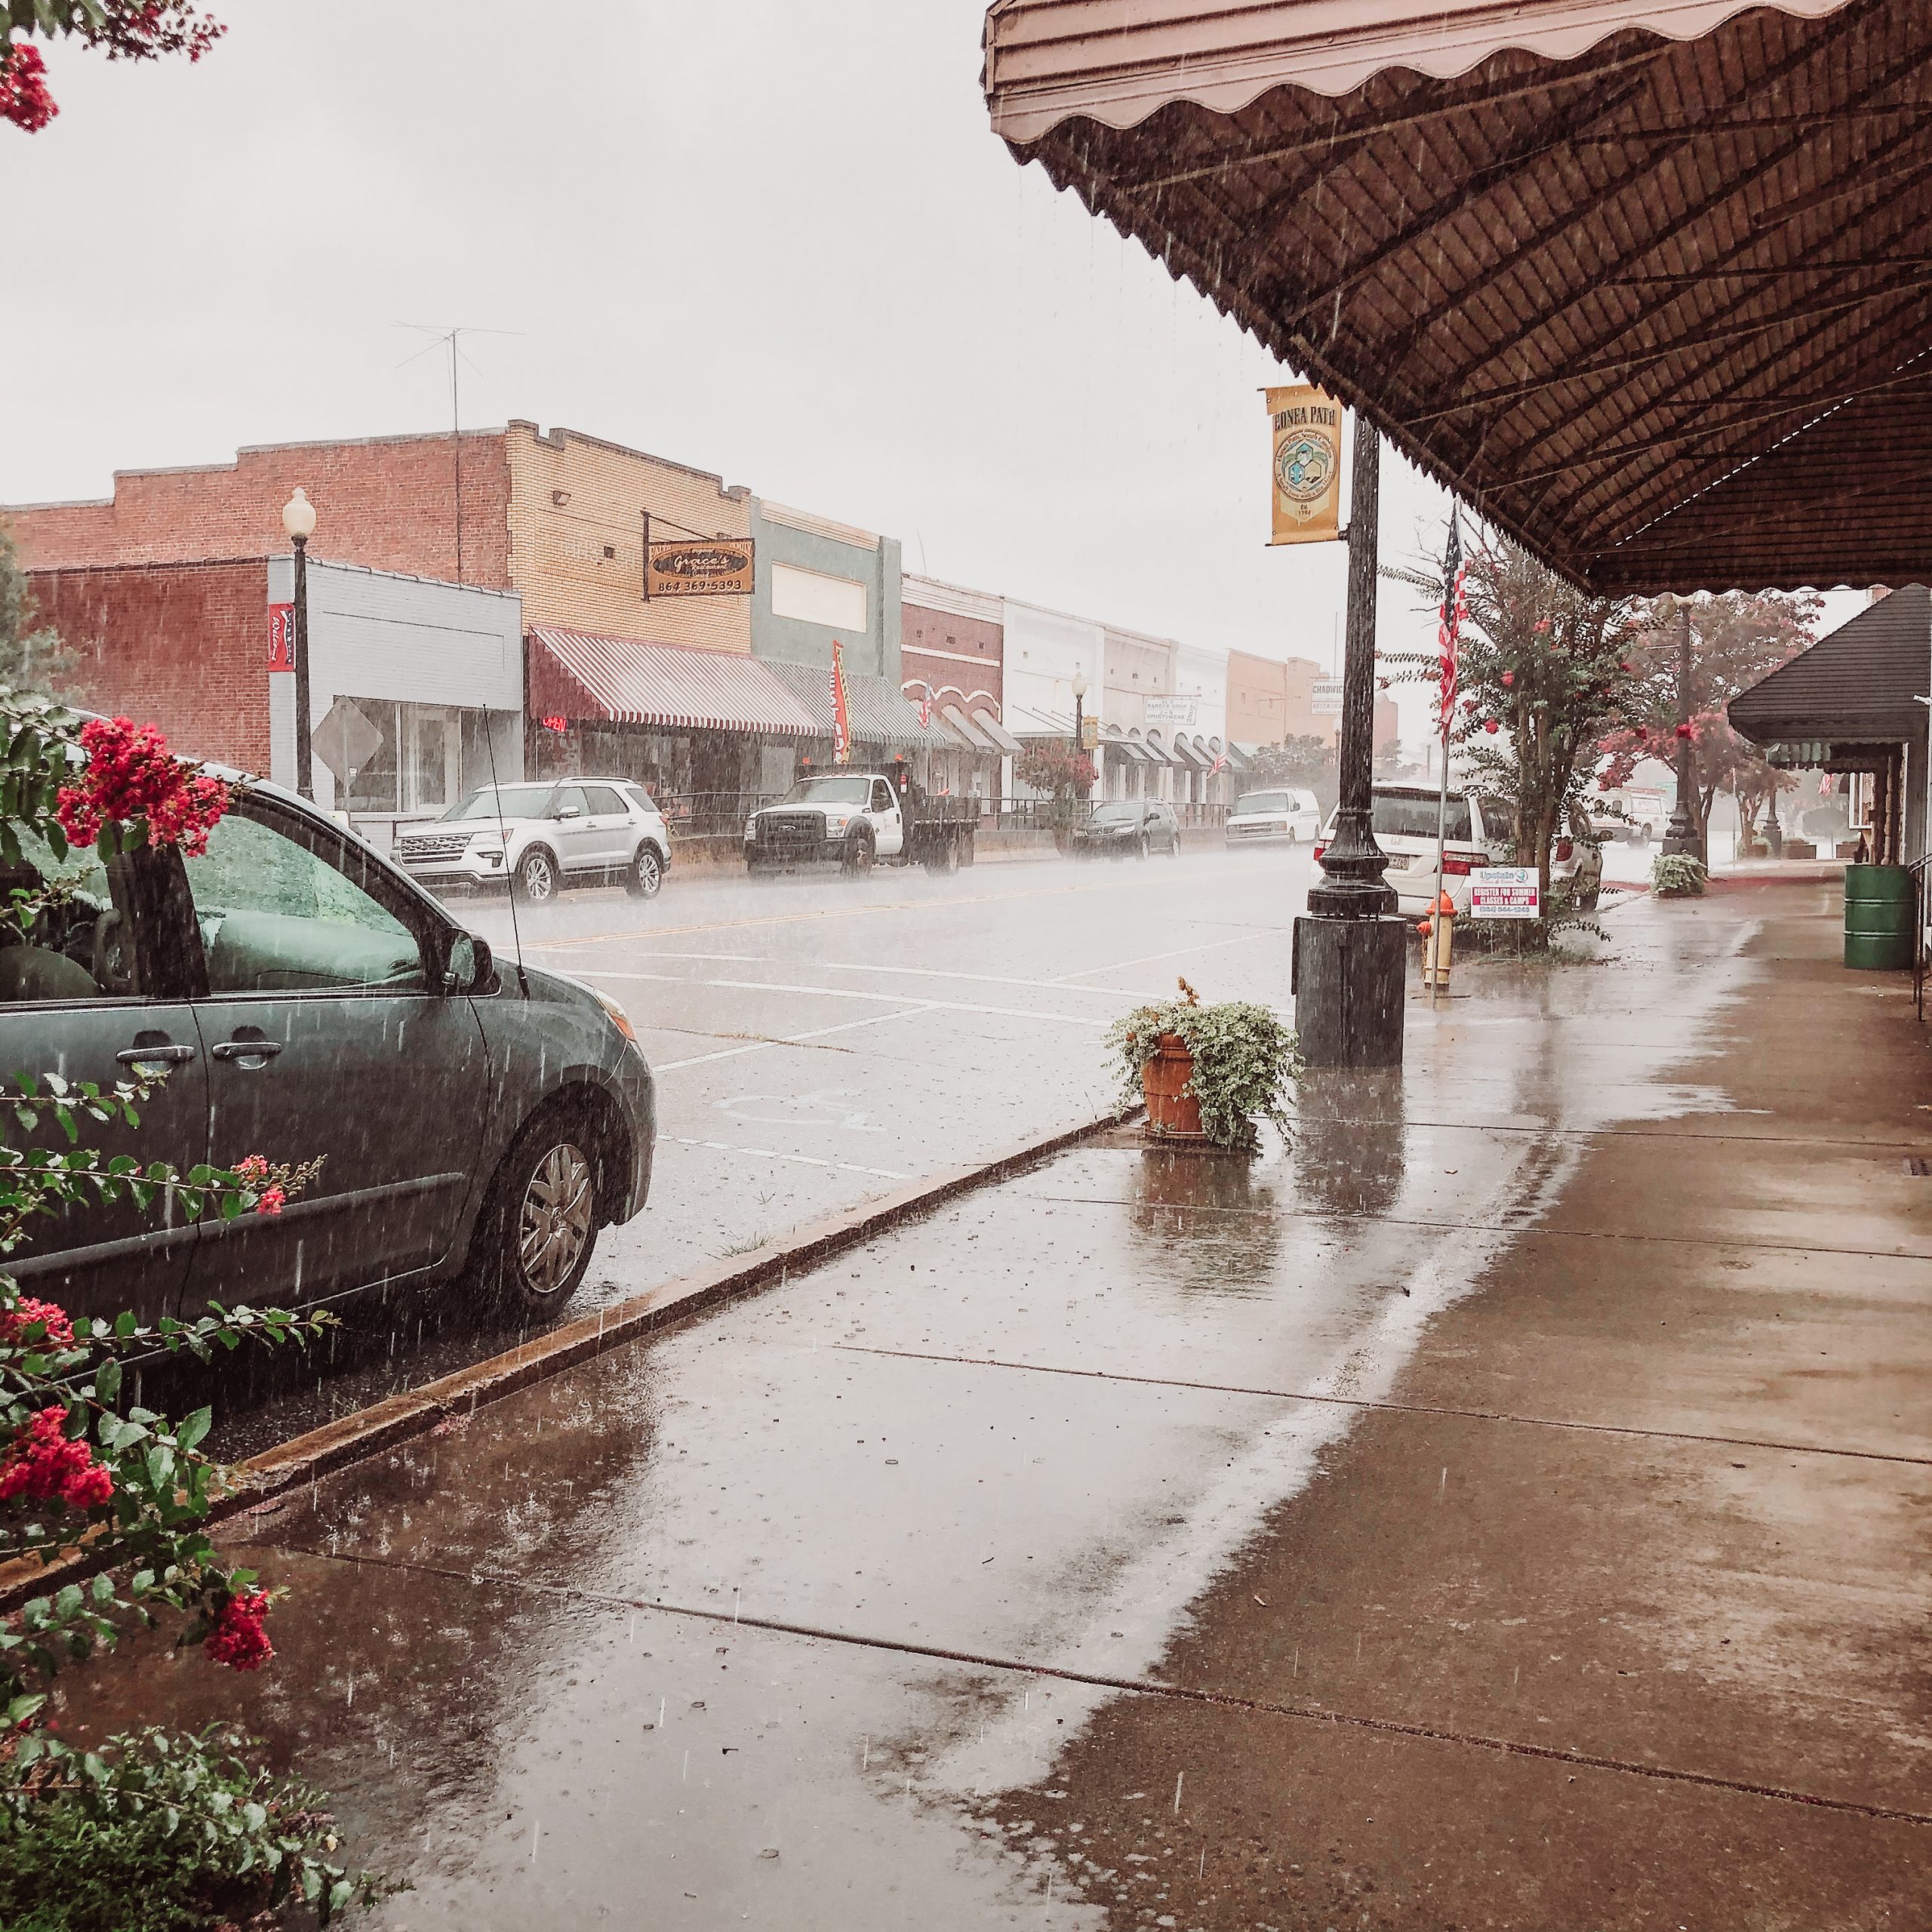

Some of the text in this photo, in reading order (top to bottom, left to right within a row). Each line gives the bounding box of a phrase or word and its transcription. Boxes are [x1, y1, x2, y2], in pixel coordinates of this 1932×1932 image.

[1310, 406, 1336, 427] PATH
[649, 545, 672, 561] FAITH
[730, 541, 752, 558] FAMILY
[674, 555, 730, 573] Grace's
[659, 582, 681, 592] 864
[543, 717, 566, 732] OPEN
[1474, 888, 1535, 896] REGISTER FOR SUMMER
